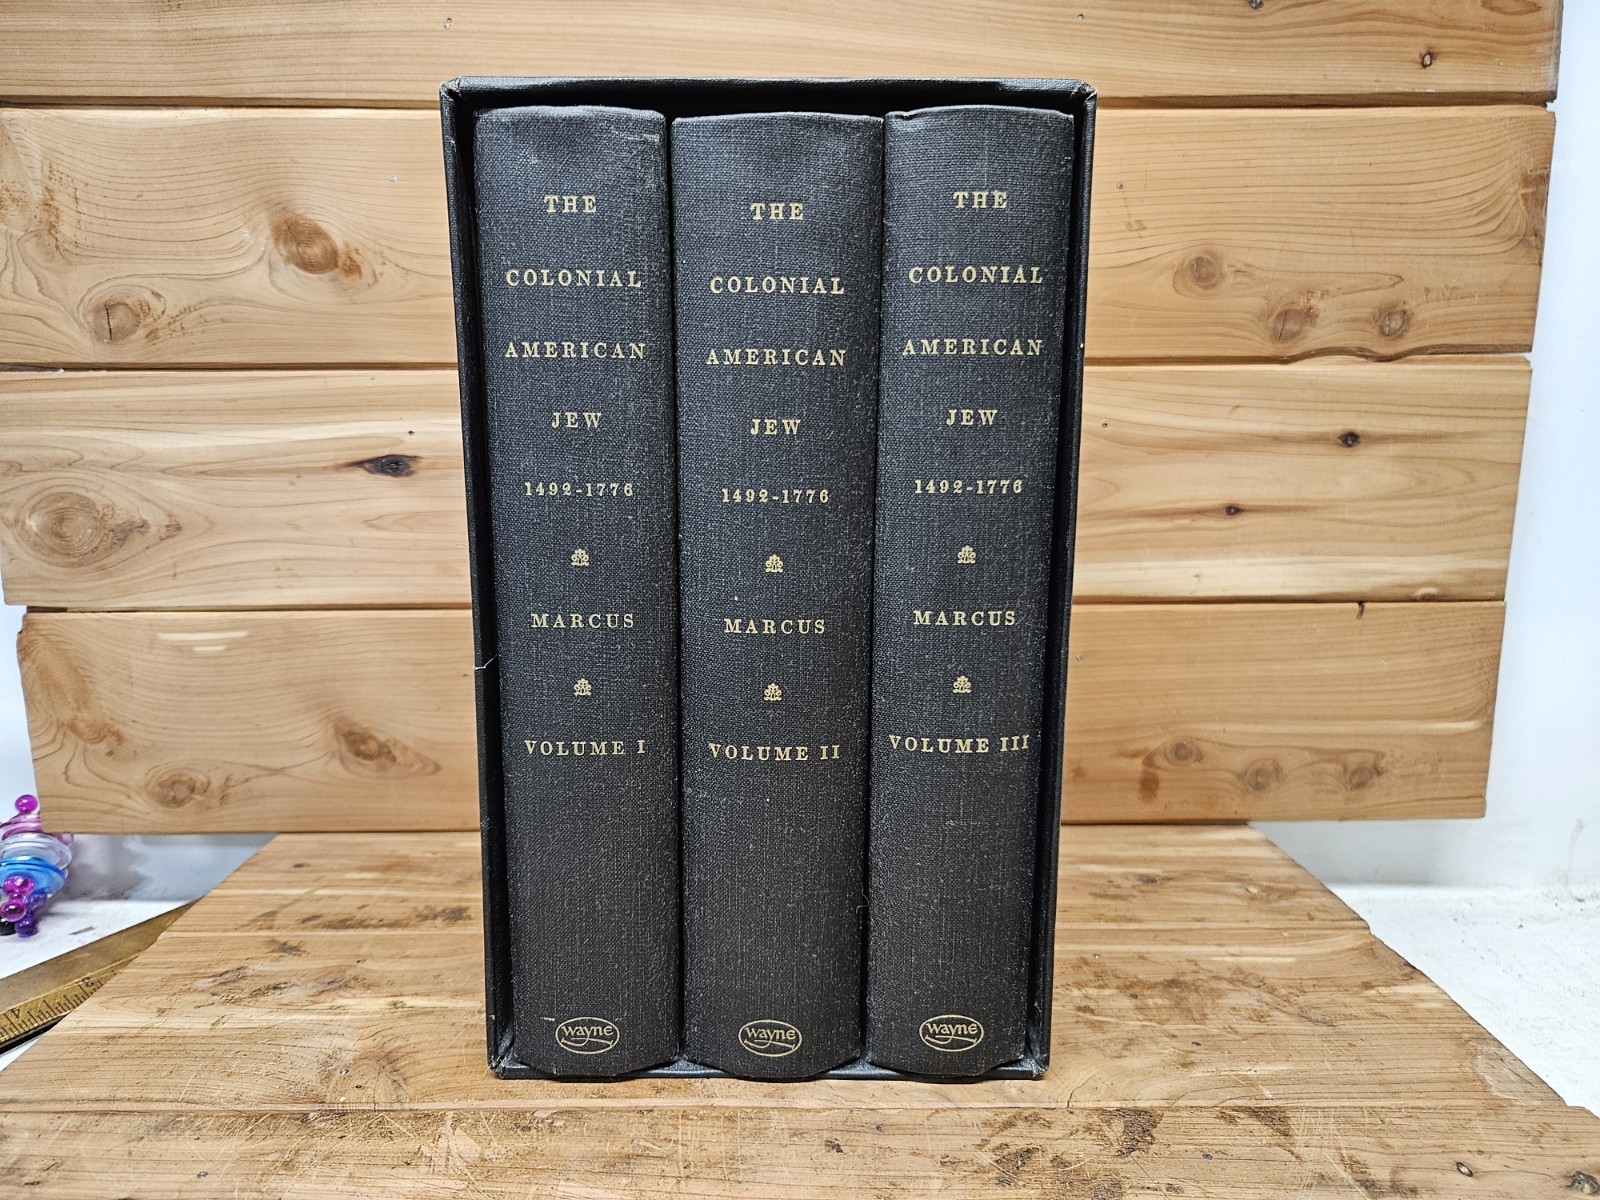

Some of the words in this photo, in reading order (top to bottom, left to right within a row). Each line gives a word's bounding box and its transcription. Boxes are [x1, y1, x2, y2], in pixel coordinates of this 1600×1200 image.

[545, 194, 596, 213] THE
[953, 191, 1007, 210] THE
[750, 202, 805, 222] THE
[505, 268, 641, 288] COLONIAL
[907, 264, 1044, 284] COLONIAL
[709, 276, 846, 296] COLONIAL
[505, 341, 645, 358] AMERICAN
[902, 338, 1042, 356] AMERICAN
[706, 348, 847, 367] AMERICAN
[551, 411, 602, 428] JEW
[945, 408, 997, 426] JEW
[750, 418, 800, 436] JEW
[524, 481, 634, 497] 1492-1776
[914, 478, 1023, 494] 1492-1776
[721, 488, 830, 505] 1492-1776
[530, 612, 635, 629] MARCUS
[724, 617, 826, 635] MARCUS
[913, 609, 1017, 627] MARCUS
[524, 739, 625, 756] VOLUME
[636, 739, 646, 754] I
[708, 742, 810, 761] VOLUME
[820, 743, 840, 760] II
[888, 734, 990, 753] VOLUME
[997, 733, 1030, 752] III
[561, 1025, 615, 1047] wayne
[744, 1027, 797, 1049] wayne
[925, 1022, 979, 1045] wayne
